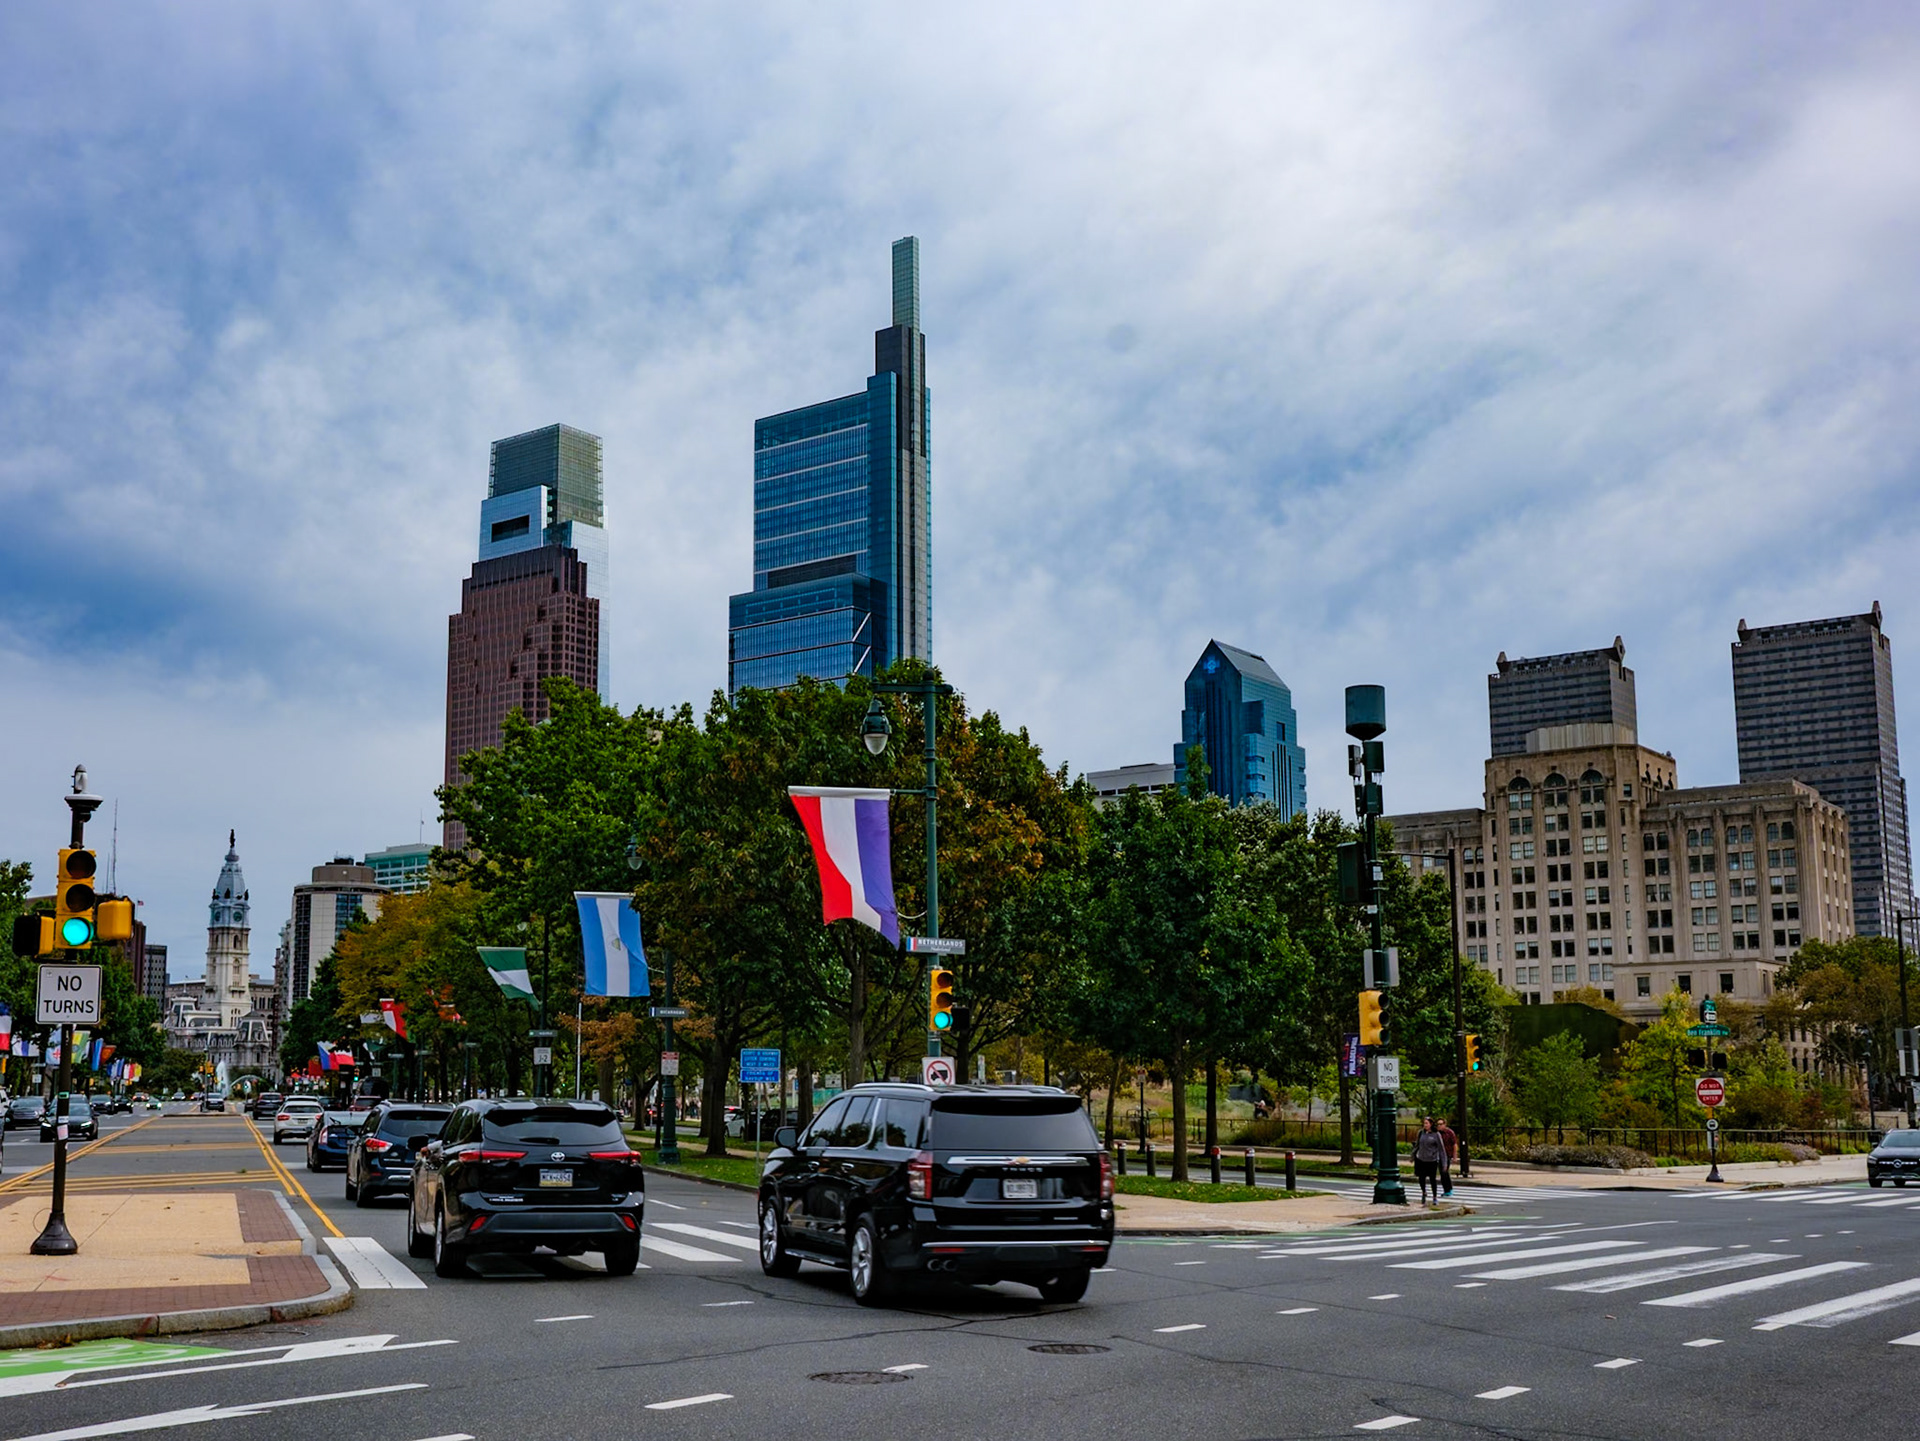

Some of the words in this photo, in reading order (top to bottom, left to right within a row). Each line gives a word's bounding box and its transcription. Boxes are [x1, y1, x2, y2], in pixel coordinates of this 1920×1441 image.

[918, 939, 963, 947] NETHERLANDS
[57, 975, 82, 992] NO
[43, 1000, 94, 1014] TURNS
[1698, 1028, 1721, 1036] Franklin
[1349, 1037, 1358, 1074] PHILADELPHIA
[1383, 1062, 1394, 1072] NO
[1380, 1075, 1398, 1084] TURNS
